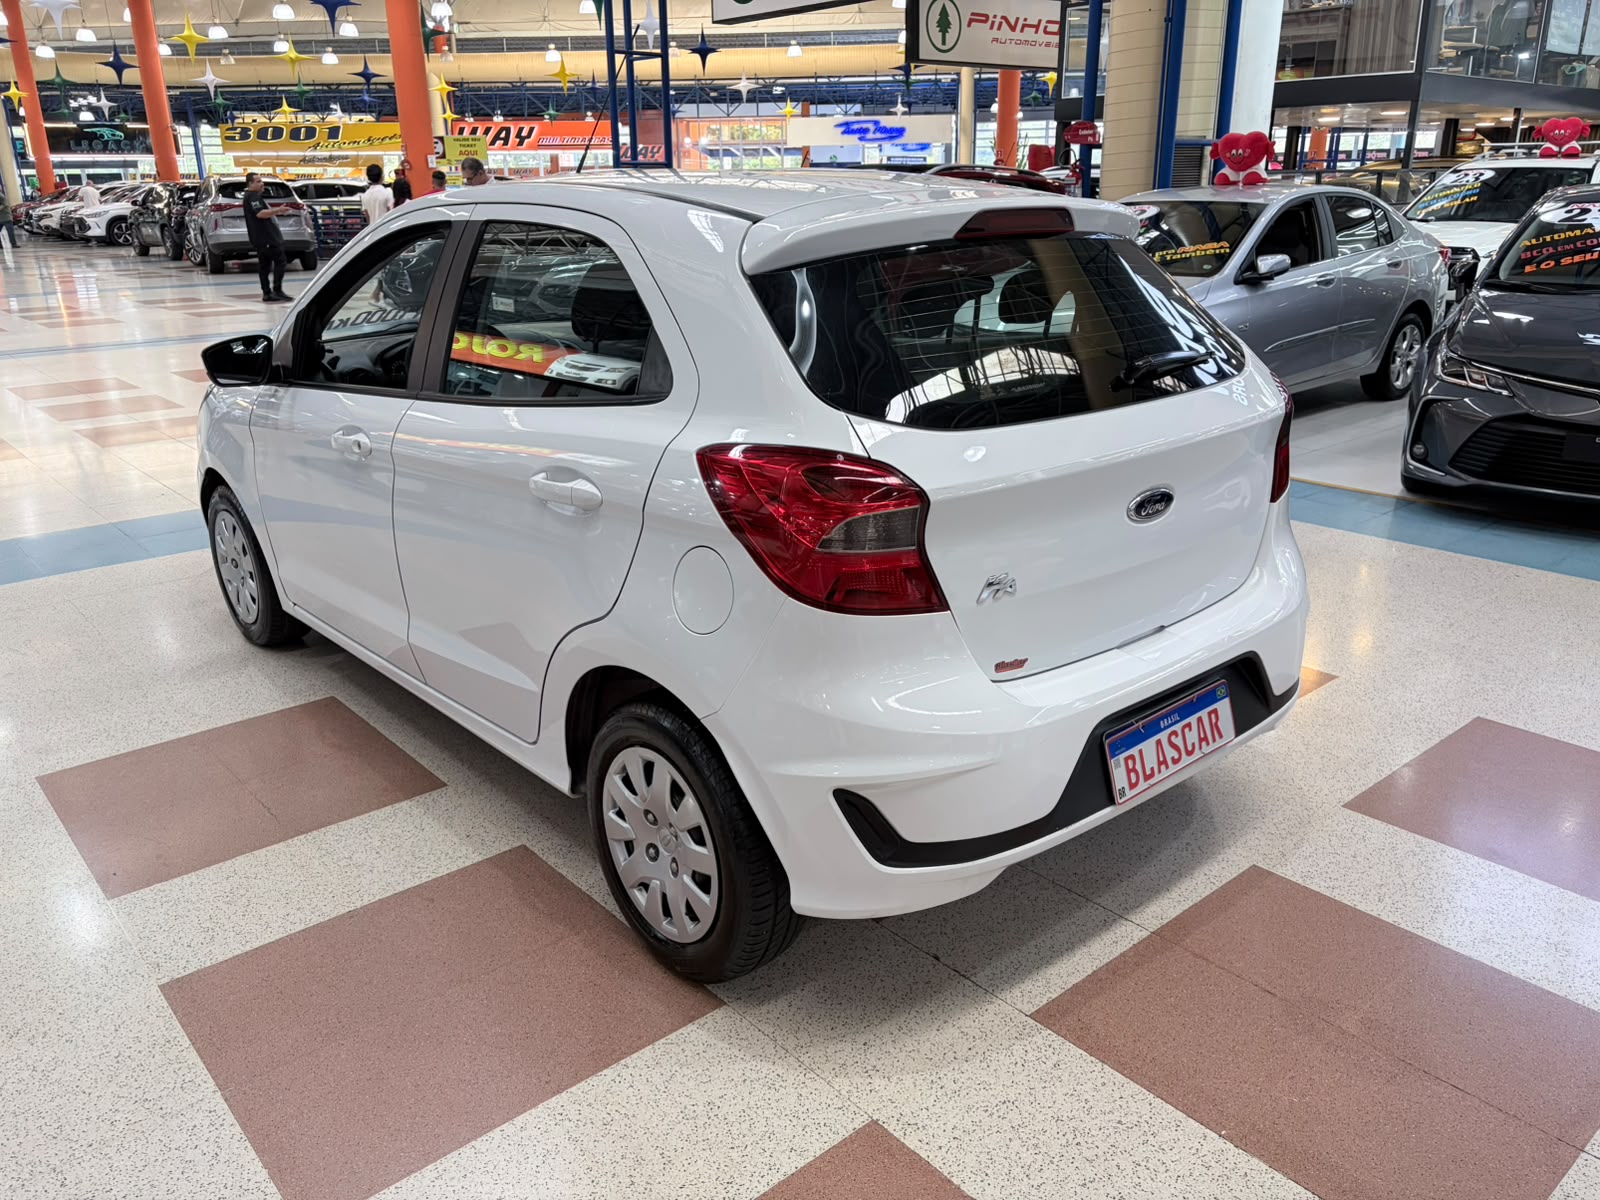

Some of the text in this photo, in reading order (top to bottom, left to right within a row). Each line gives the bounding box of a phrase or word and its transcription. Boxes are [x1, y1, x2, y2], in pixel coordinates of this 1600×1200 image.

[224, 125, 342, 142] 3001
[1450, 171, 1486, 184] 23
[1558, 207, 1600, 223] 2
[1576, 237, 1600, 249] CO
[1160, 712, 1180, 729] BRASIL
[1123, 707, 1224, 792] BLASCAR
[1118, 786, 1127, 800] BR
